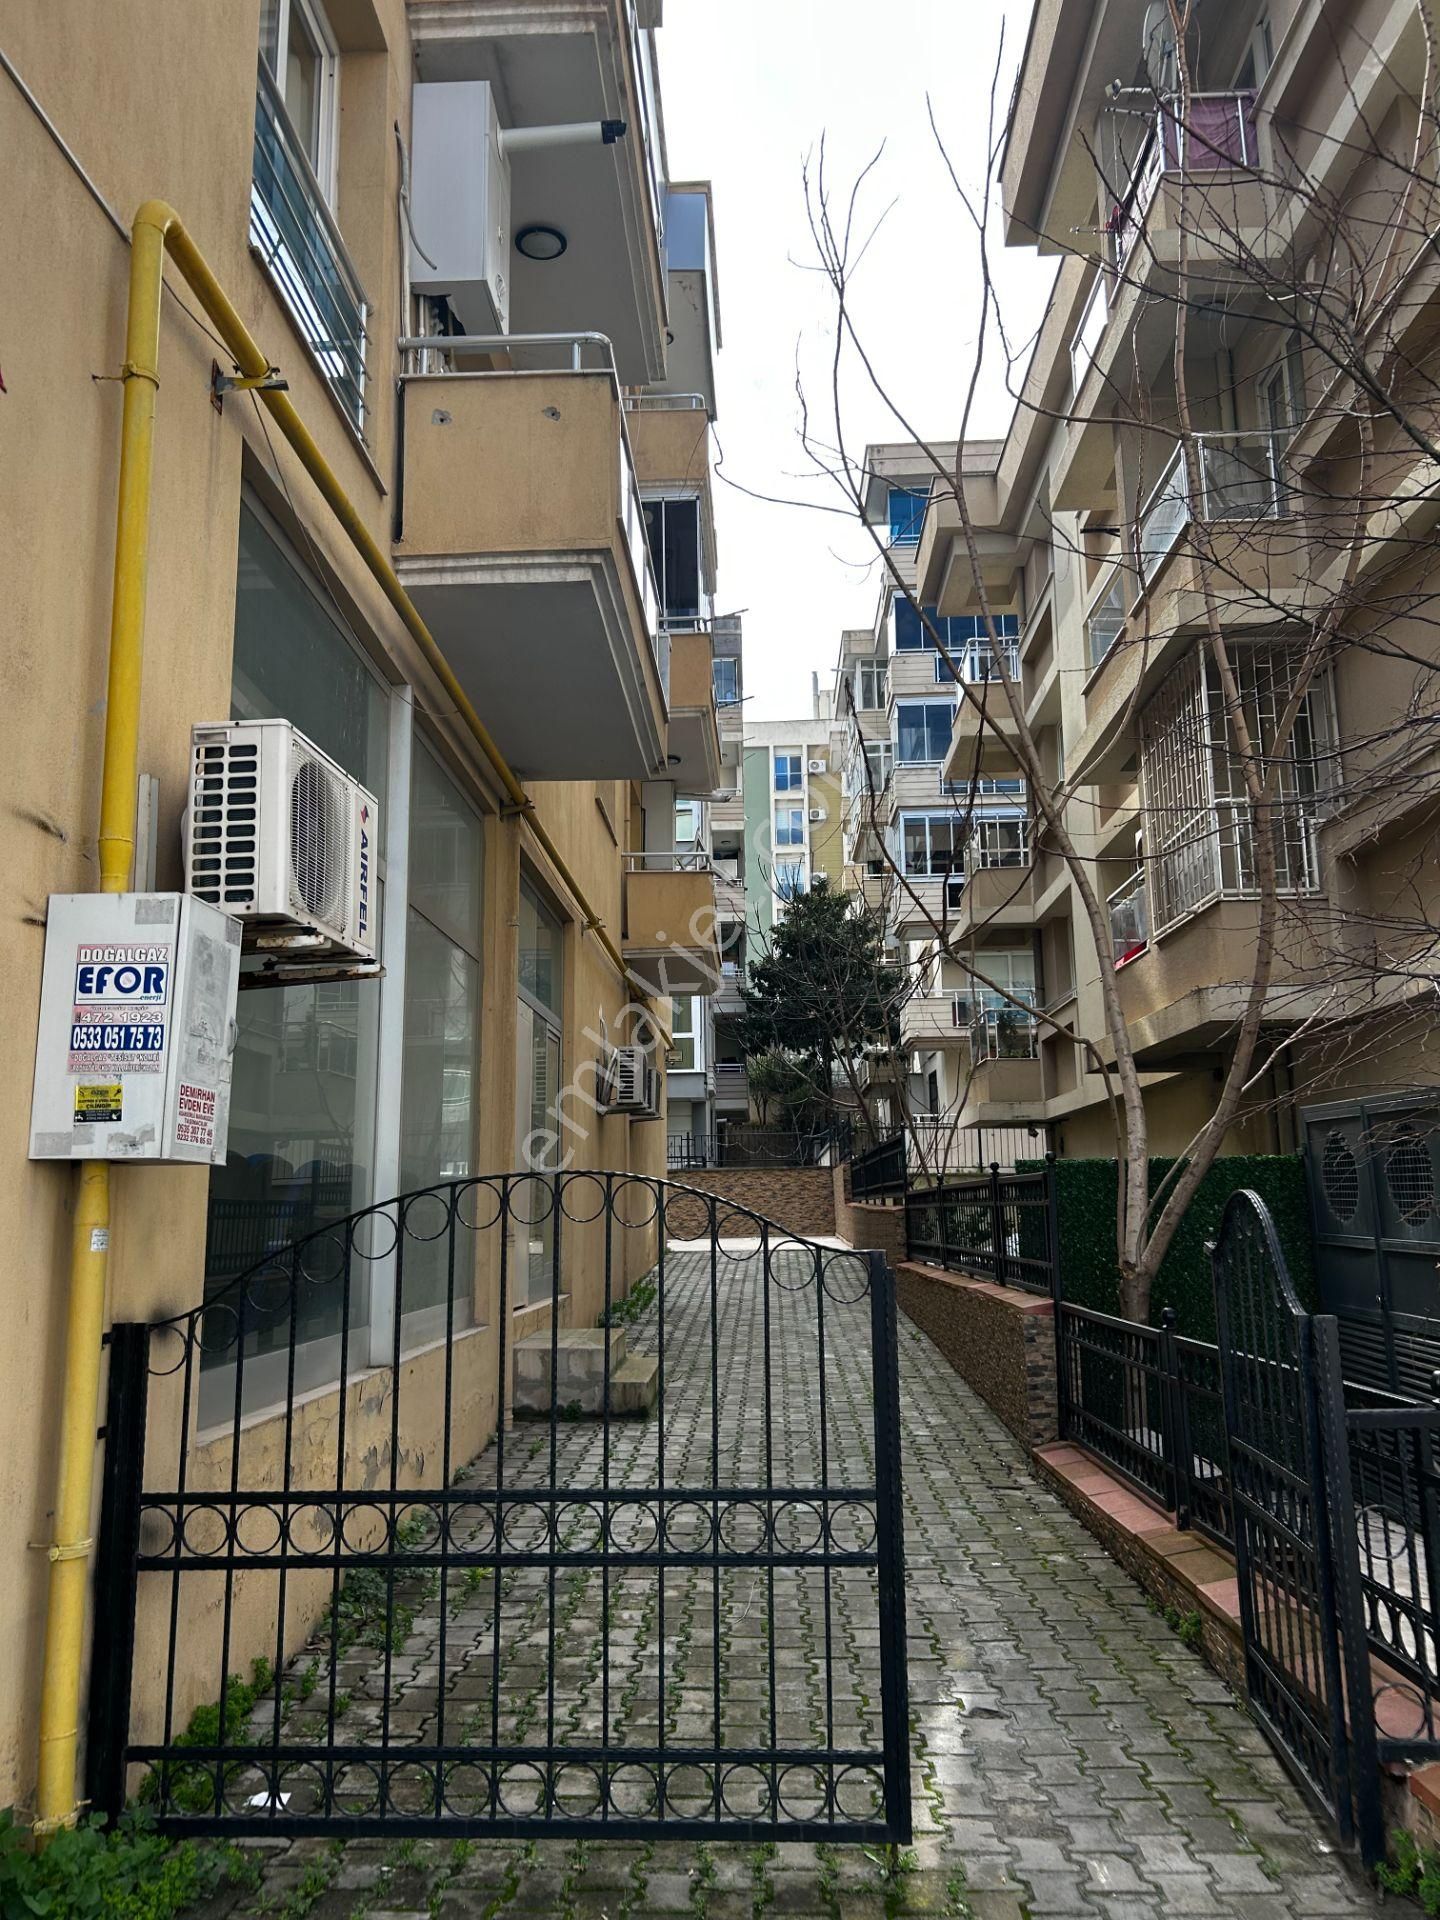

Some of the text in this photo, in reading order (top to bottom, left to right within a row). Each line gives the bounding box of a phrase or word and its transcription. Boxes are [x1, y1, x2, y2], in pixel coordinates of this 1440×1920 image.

[359, 828, 369, 938] AIRFEL
[80, 946, 168, 962] DOĞALGAZ
[79, 966, 164, 994] EFOR
[81, 1011, 114, 1023] 472
[120, 1011, 163, 1023] 1923
[73, 1026, 162, 1049] 0533 051 75 73
[179, 1098, 214, 1115] EVDEN EVE
